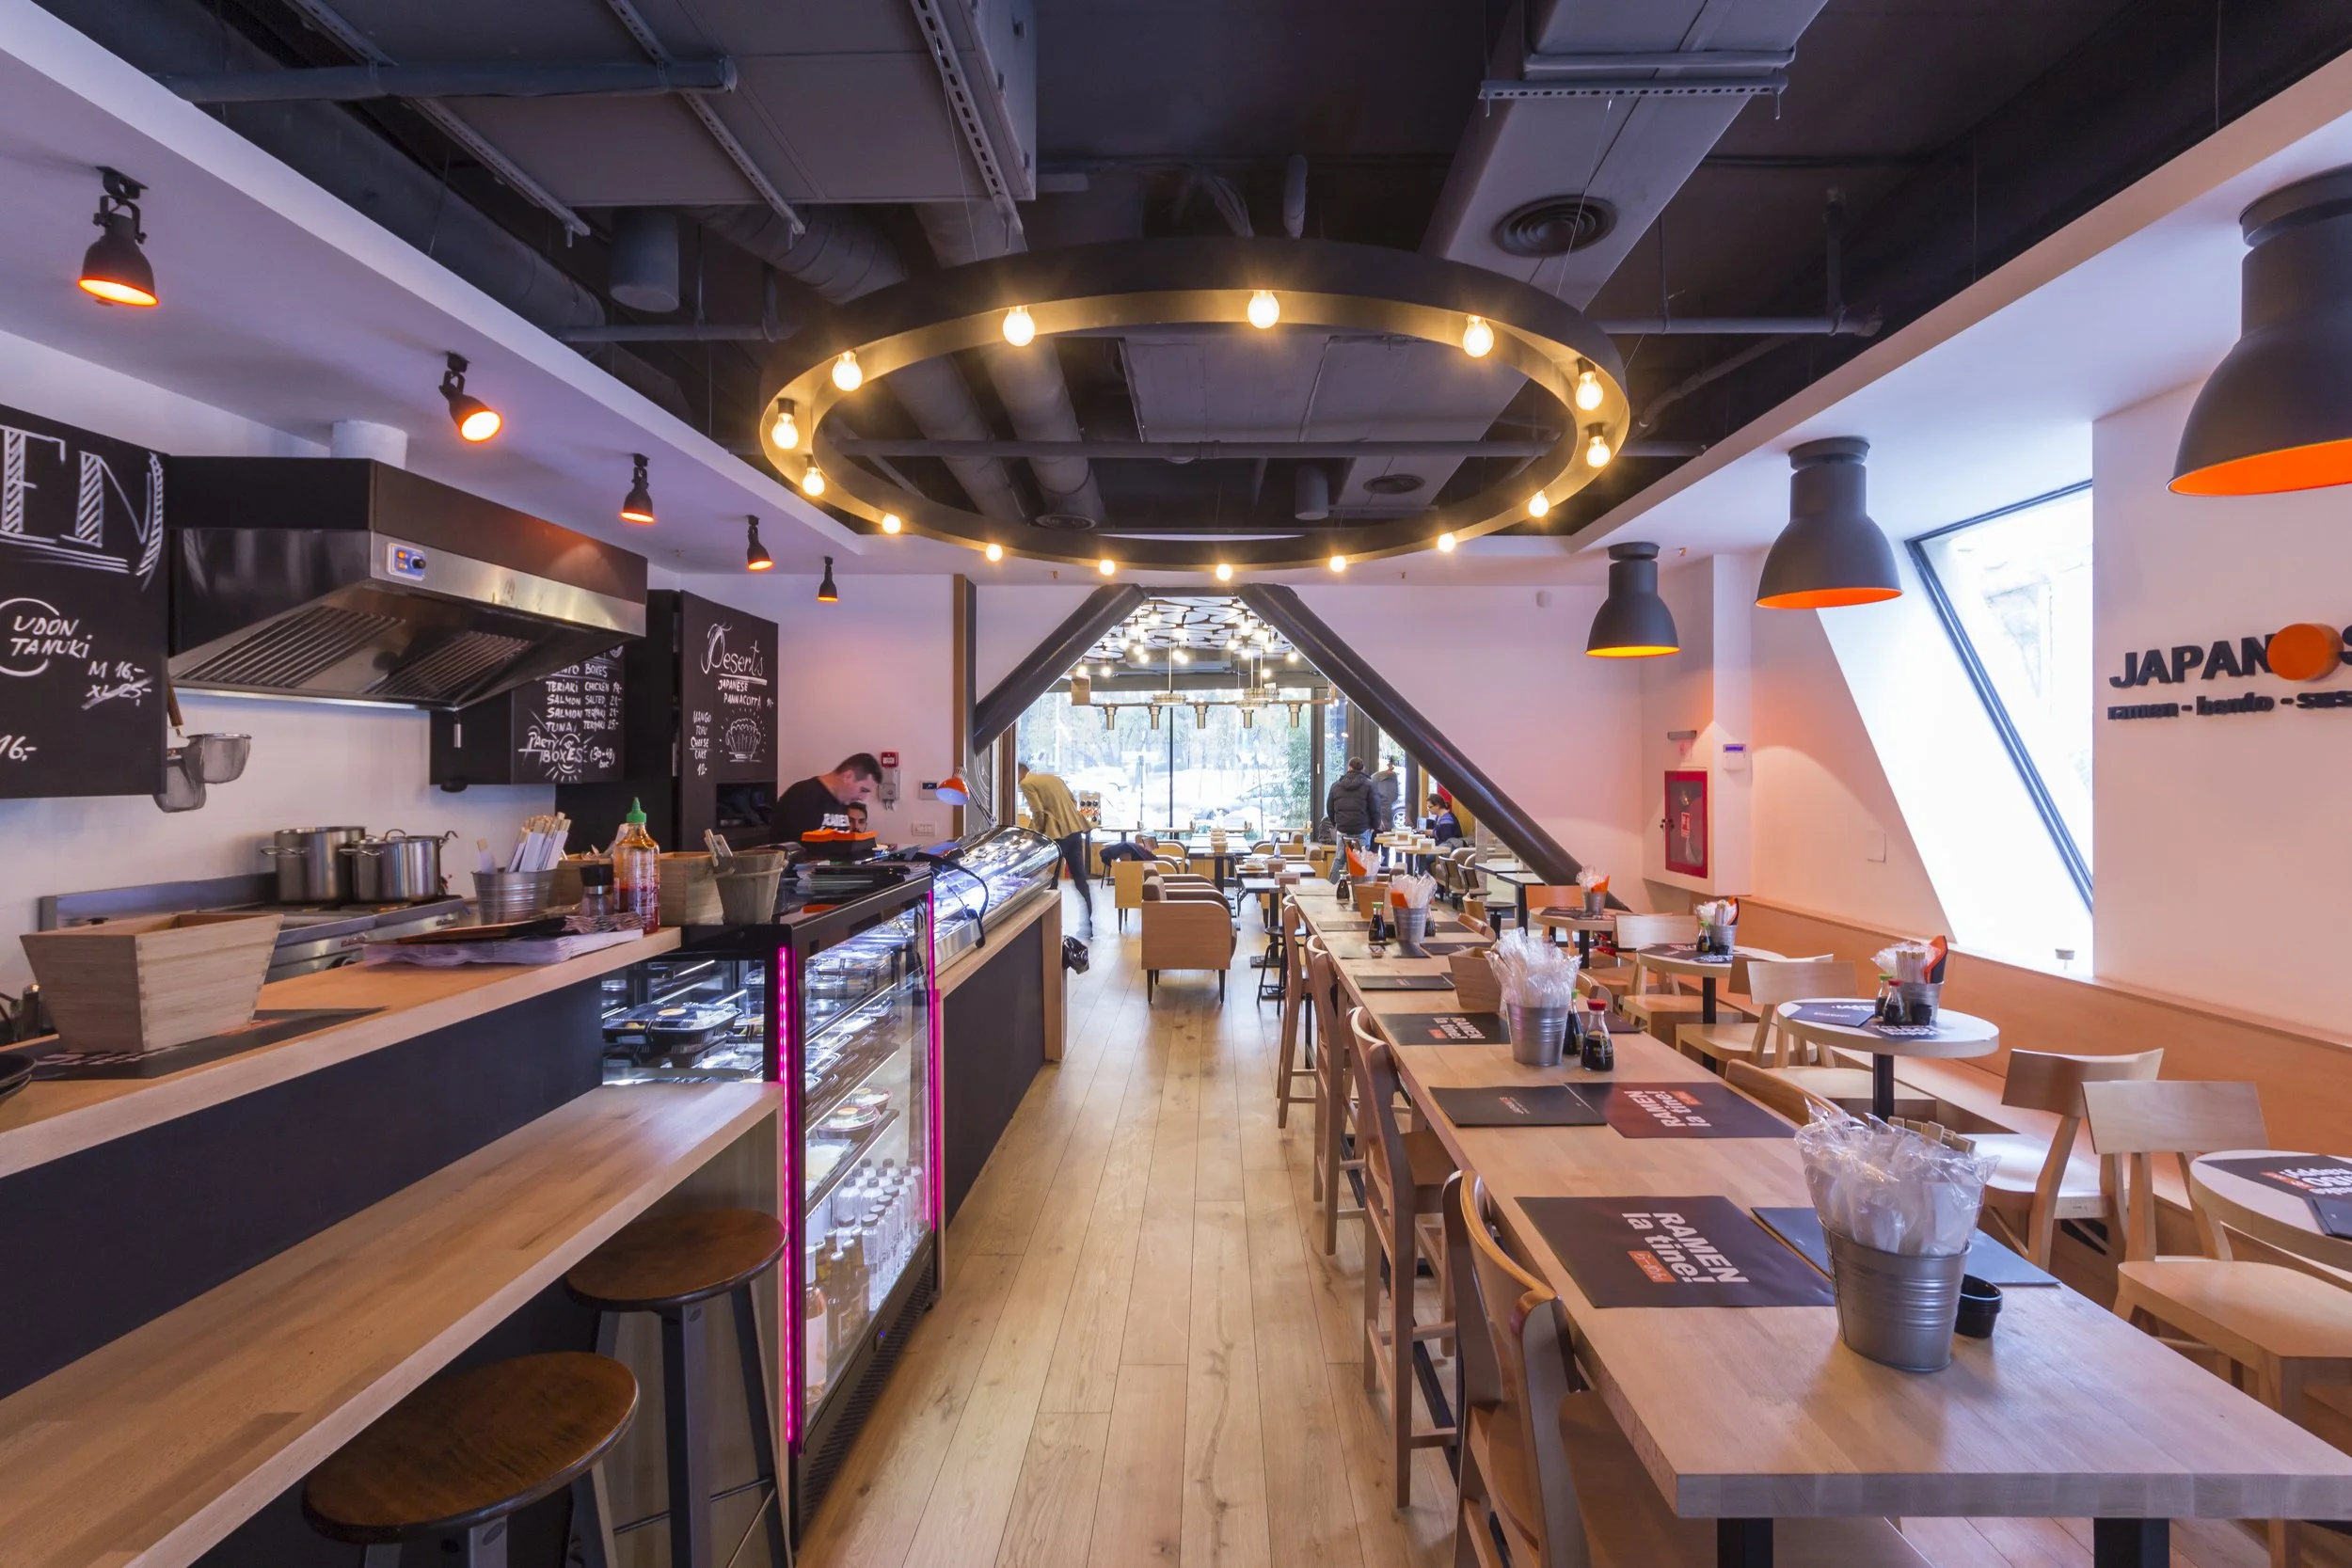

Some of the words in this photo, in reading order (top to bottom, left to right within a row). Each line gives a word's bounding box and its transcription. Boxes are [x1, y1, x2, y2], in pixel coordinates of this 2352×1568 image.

[13, 615, 79, 637] UDON
[87, 661, 108, 678] M
[585, 663, 608, 678] BOXES
[584, 682, 610, 692] CHICKEN
[718, 678, 749, 692] JAPANESE
[547, 694, 581, 705] SALMON
[547, 707, 583, 720] SALMON
[692, 710, 712, 723] MANGO
[541, 748, 583, 764] BOXES
[1624, 1090, 1687, 1128] RAMEN
[1685, 1116, 1712, 1128] la
[1621, 1212, 1653, 1229] la
[1645, 1234, 1717, 1283] tine!
[1652, 1212, 1750, 1283] RAMEN
